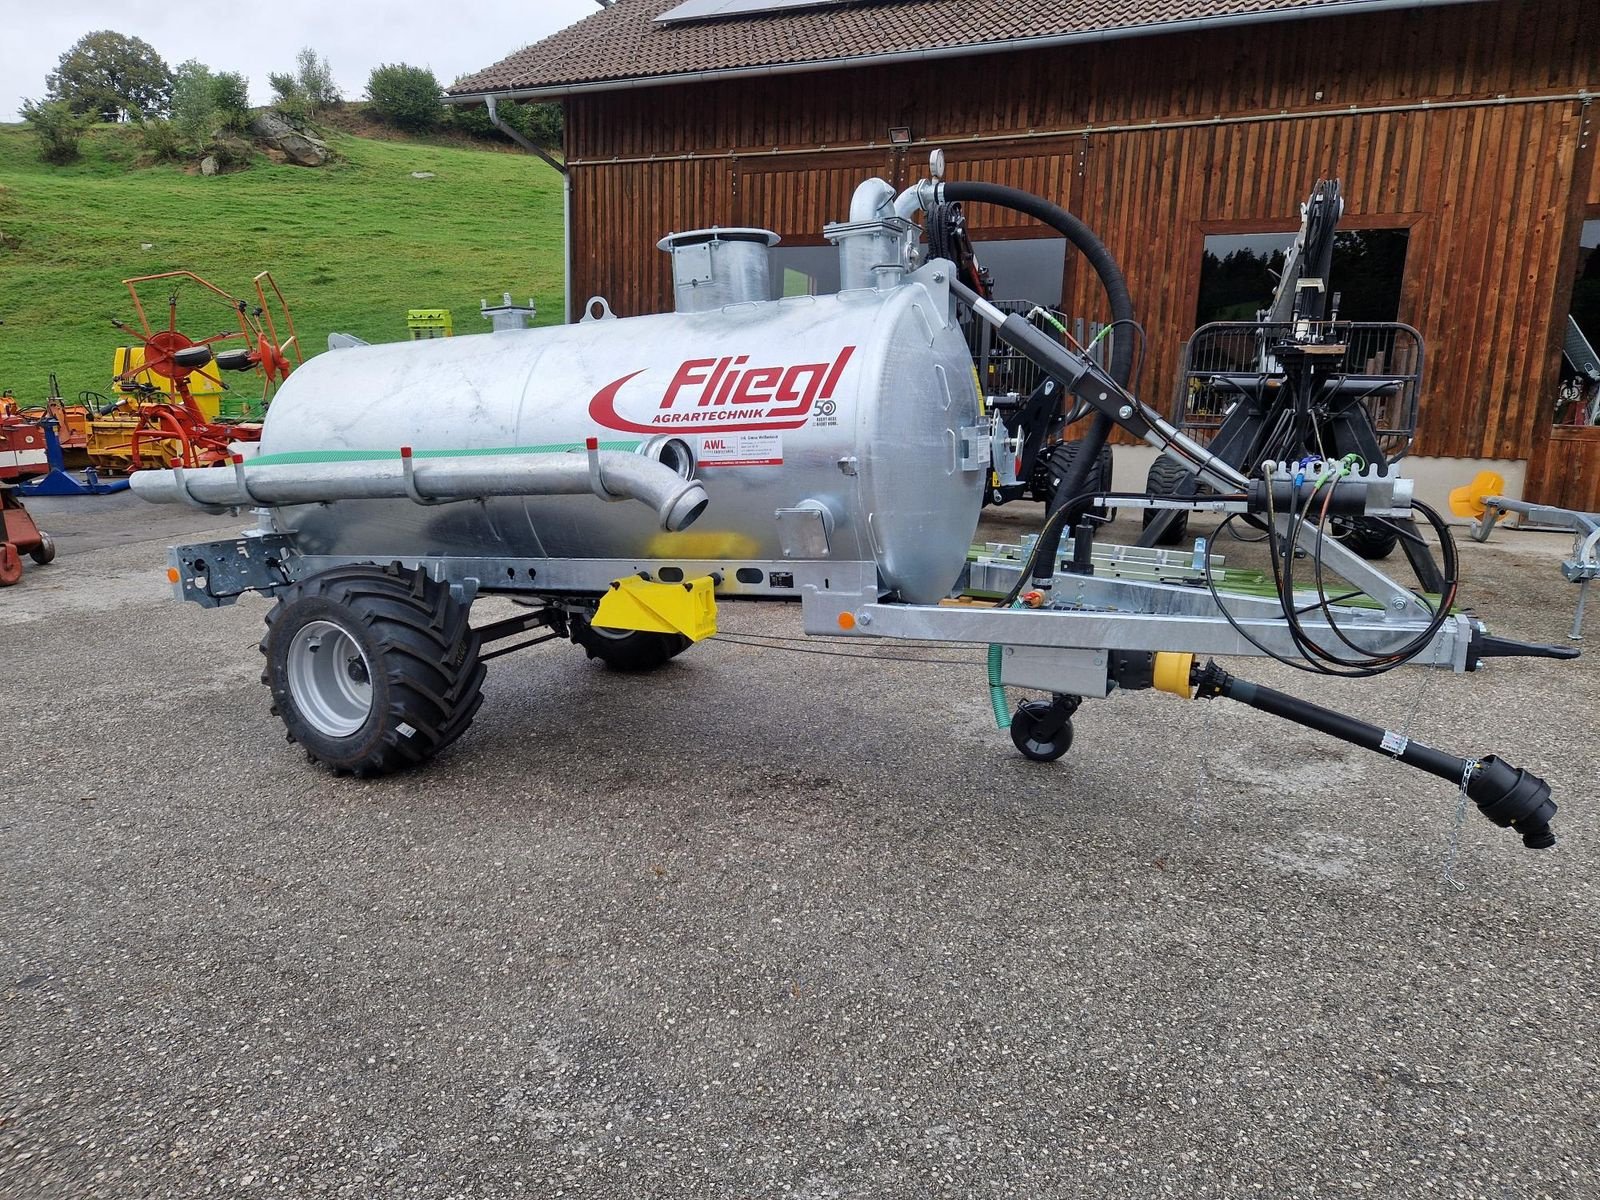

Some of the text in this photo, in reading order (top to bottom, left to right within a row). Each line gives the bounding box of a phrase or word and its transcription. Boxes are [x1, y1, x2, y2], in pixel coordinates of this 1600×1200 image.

[659, 346, 856, 417] Fliegl
[652, 408, 764, 424] AGRARTECHNIK
[703, 440, 726, 450] AWL
